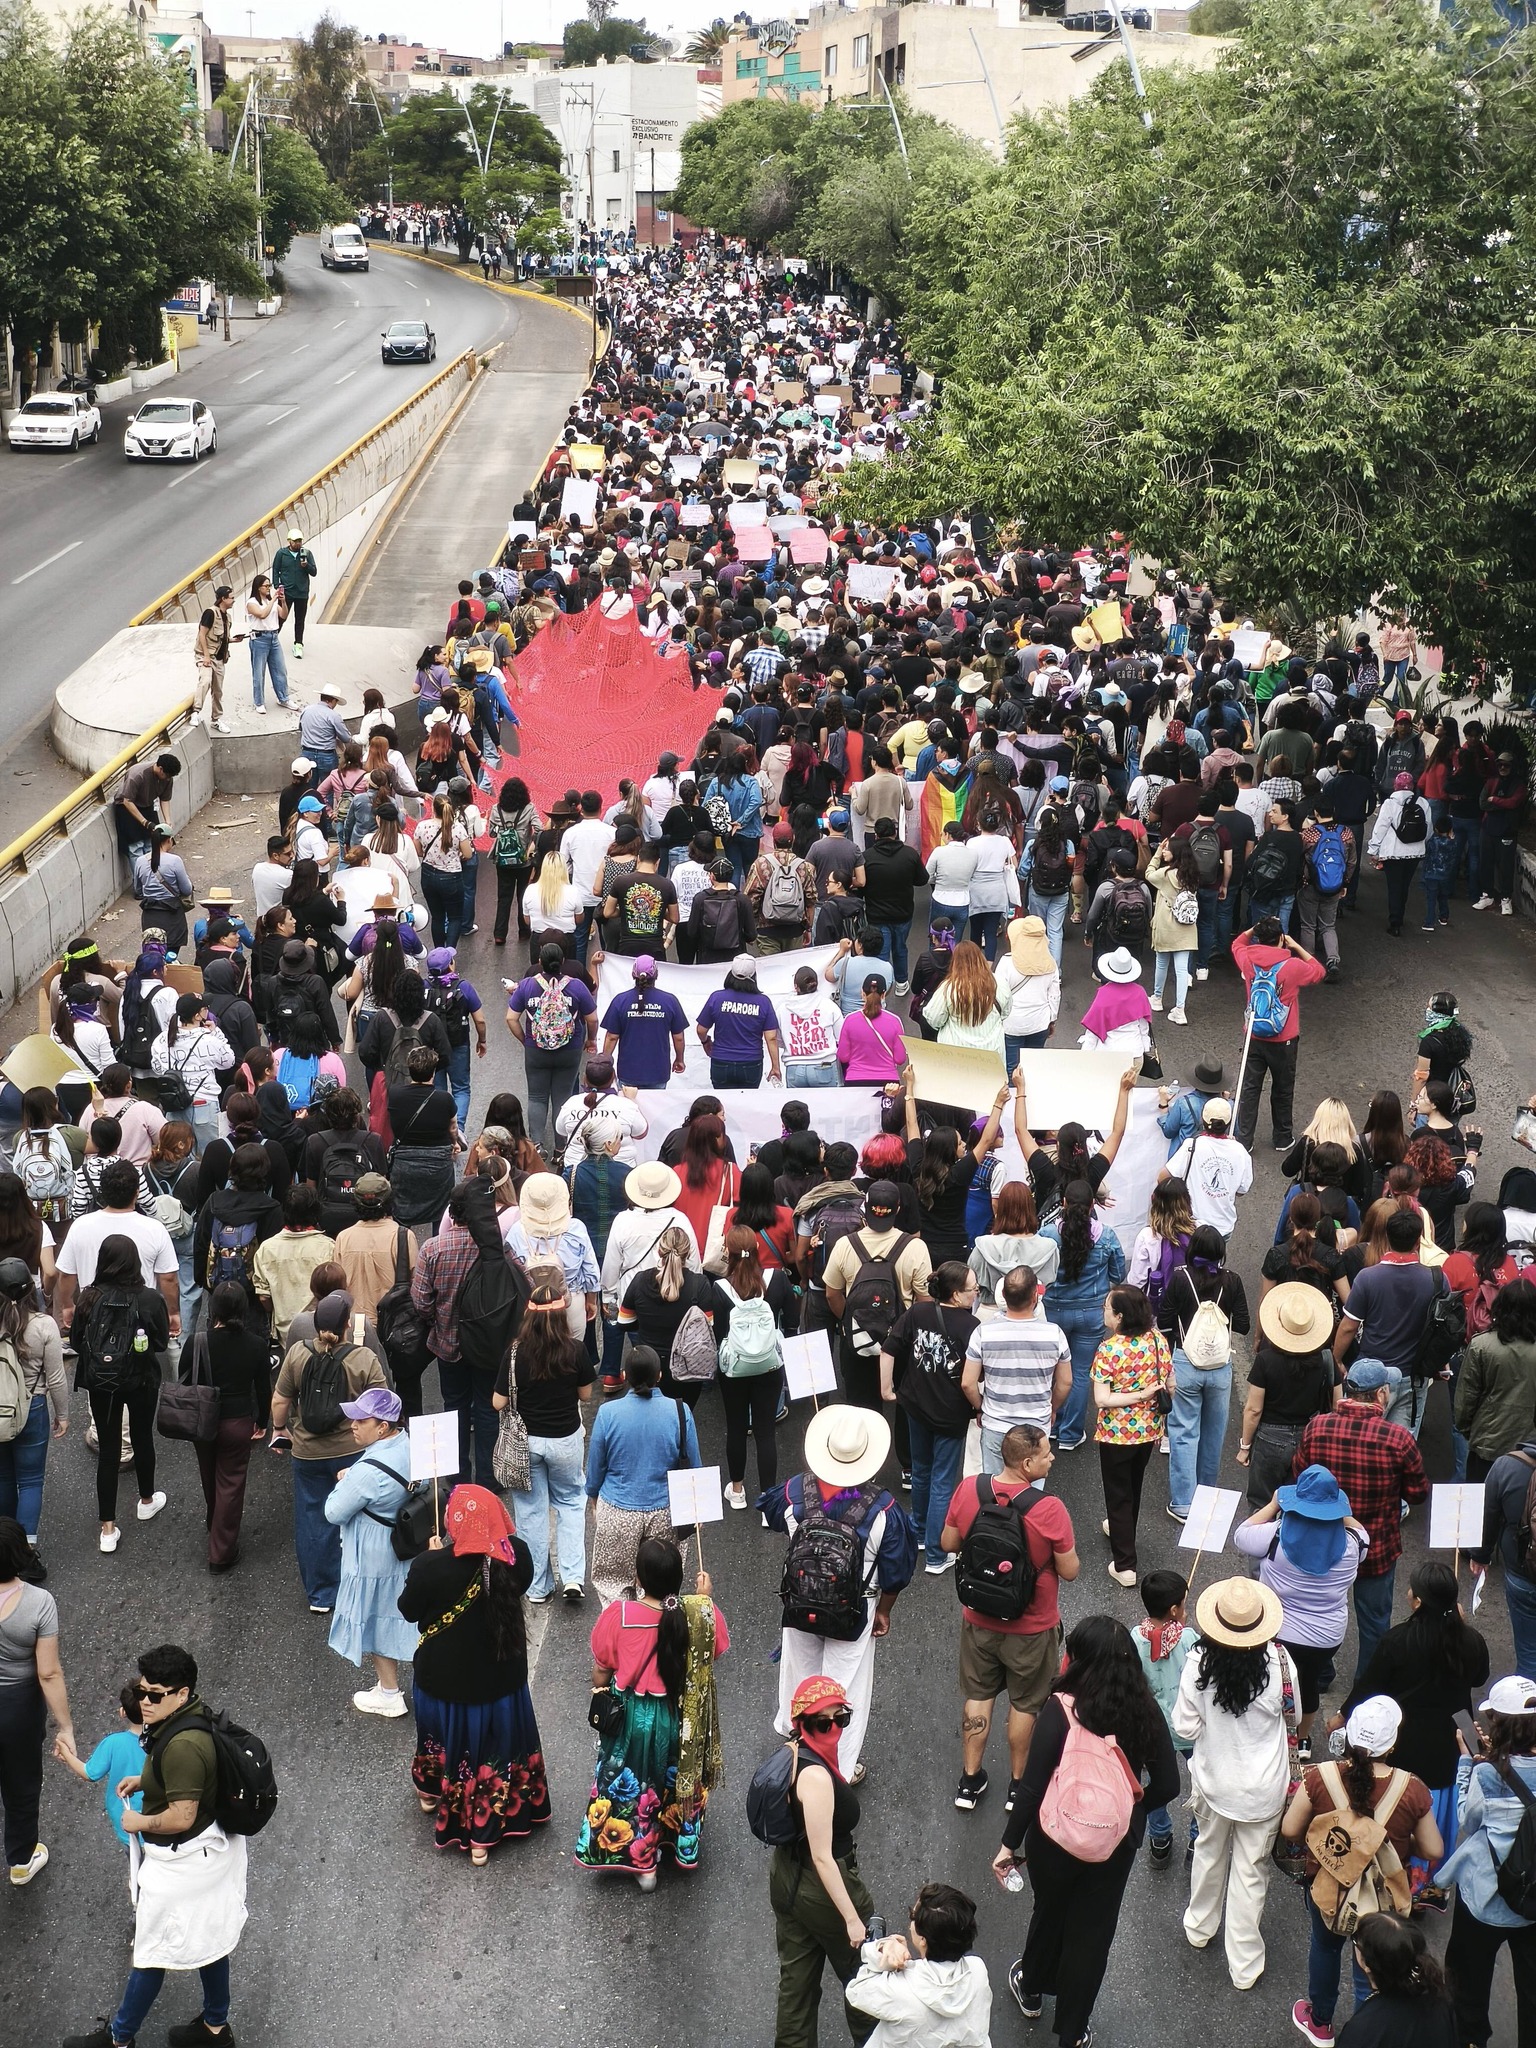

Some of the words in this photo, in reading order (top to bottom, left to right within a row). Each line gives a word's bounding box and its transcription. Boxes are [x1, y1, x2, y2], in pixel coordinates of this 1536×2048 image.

[631, 118, 679, 127] ESTACIONAMIENTO
[631, 125, 659, 133] EXCLUSIVO
[638, 132, 673, 141] BANORTE
[721, 1001, 760, 1016] #PARO8M
[789, 1026, 826, 1047] EVERY
[789, 1038, 830, 1056] MINUTE
